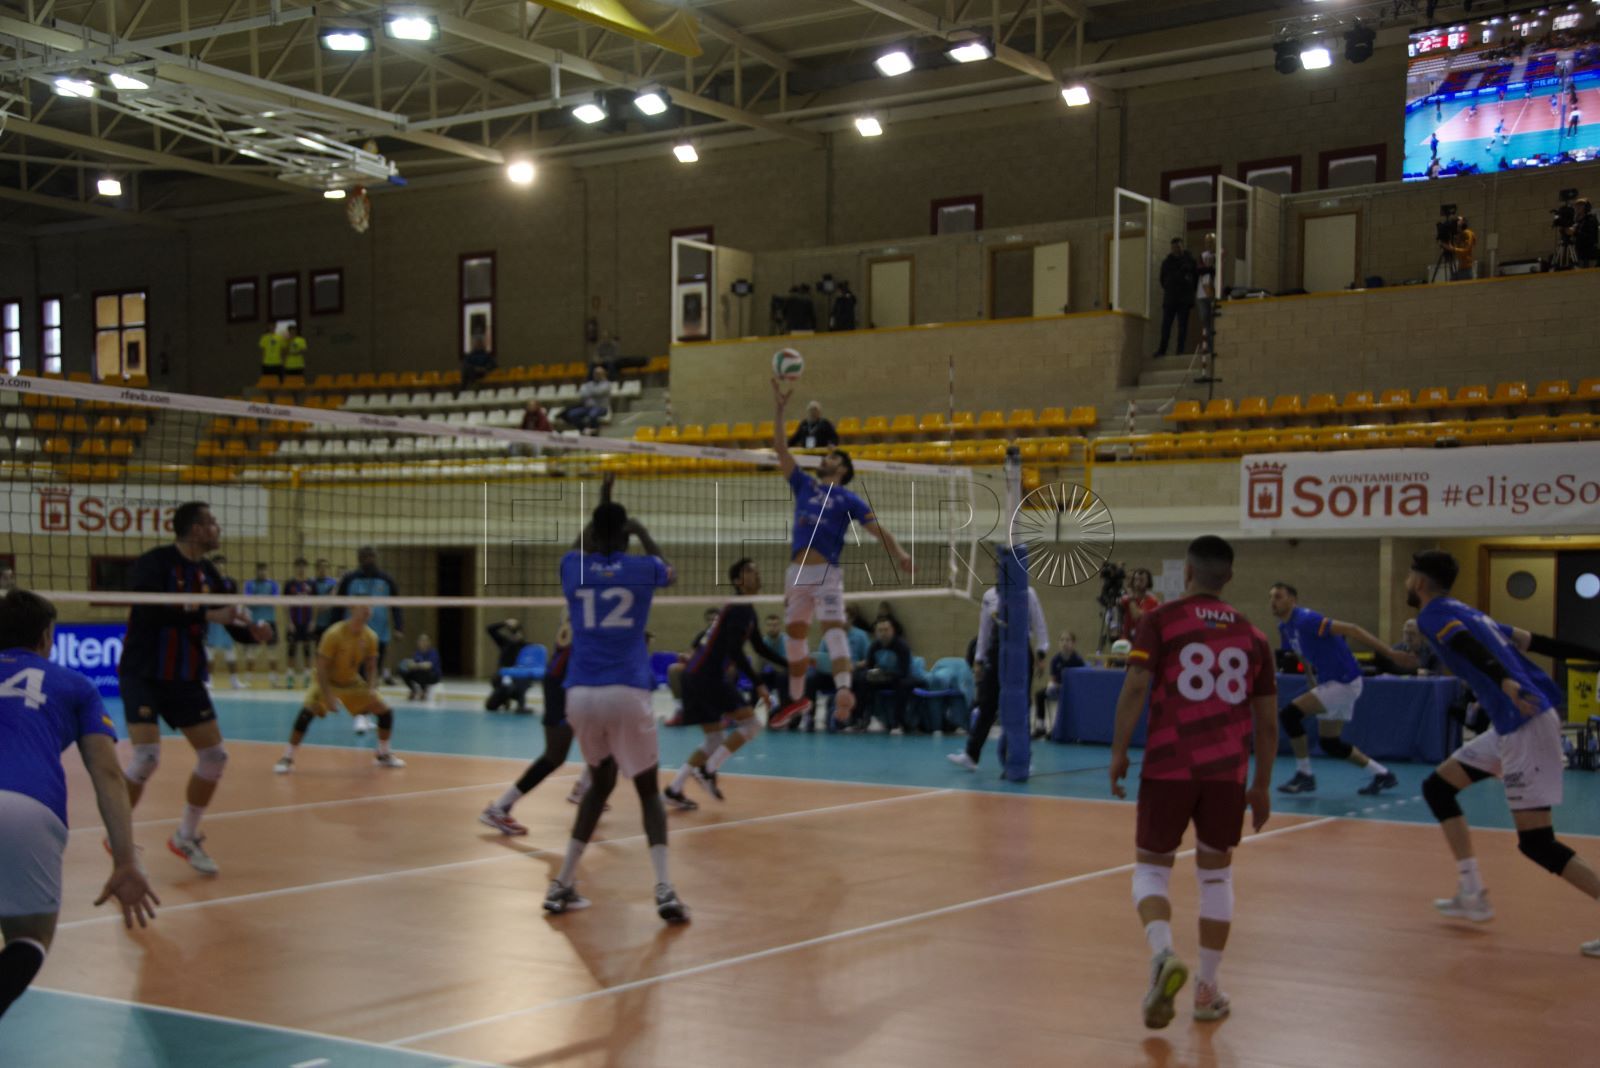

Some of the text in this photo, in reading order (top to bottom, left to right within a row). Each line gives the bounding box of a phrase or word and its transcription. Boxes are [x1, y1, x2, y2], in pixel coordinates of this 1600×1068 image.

[1291, 474, 1429, 519] Soria
[1328, 471, 1430, 483] AYUNTAMIENTO
[574, 586, 635, 629] 12
[1194, 606, 1235, 623] UNAI
[0, 666, 48, 710] 4
[1177, 641, 1249, 705] 88
